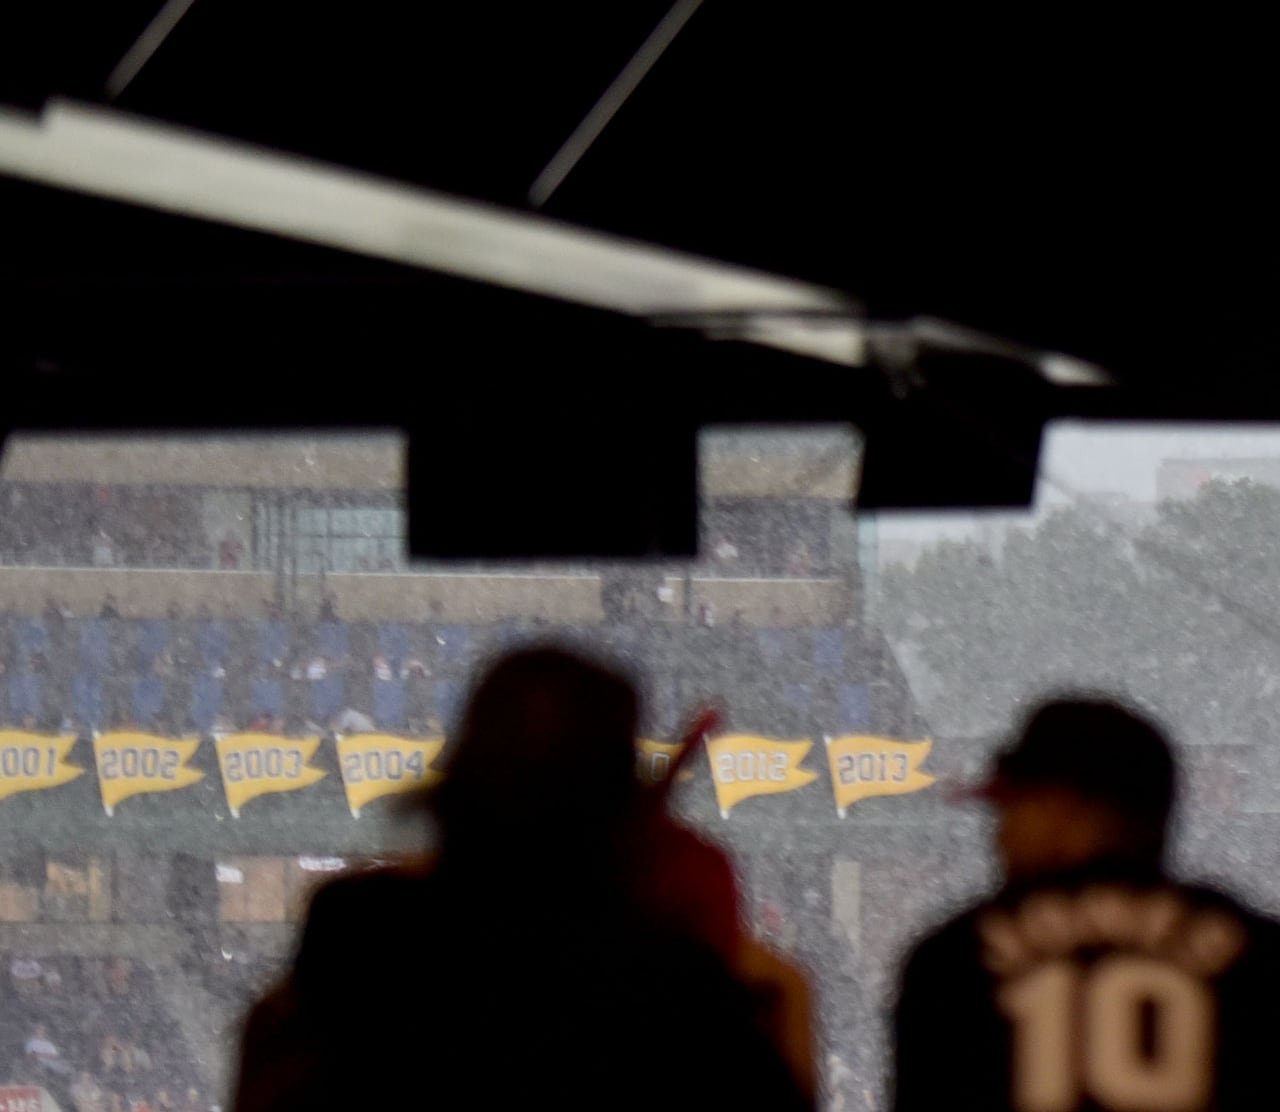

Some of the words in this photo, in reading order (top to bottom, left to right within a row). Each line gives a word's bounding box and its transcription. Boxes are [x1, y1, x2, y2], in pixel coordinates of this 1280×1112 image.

[0, 747, 57, 778] 001
[101, 747, 180, 781] 2002
[224, 747, 302, 783] 2003
[343, 750, 426, 784] 2004
[716, 751, 789, 783] 2012
[838, 752, 908, 785] 2013
